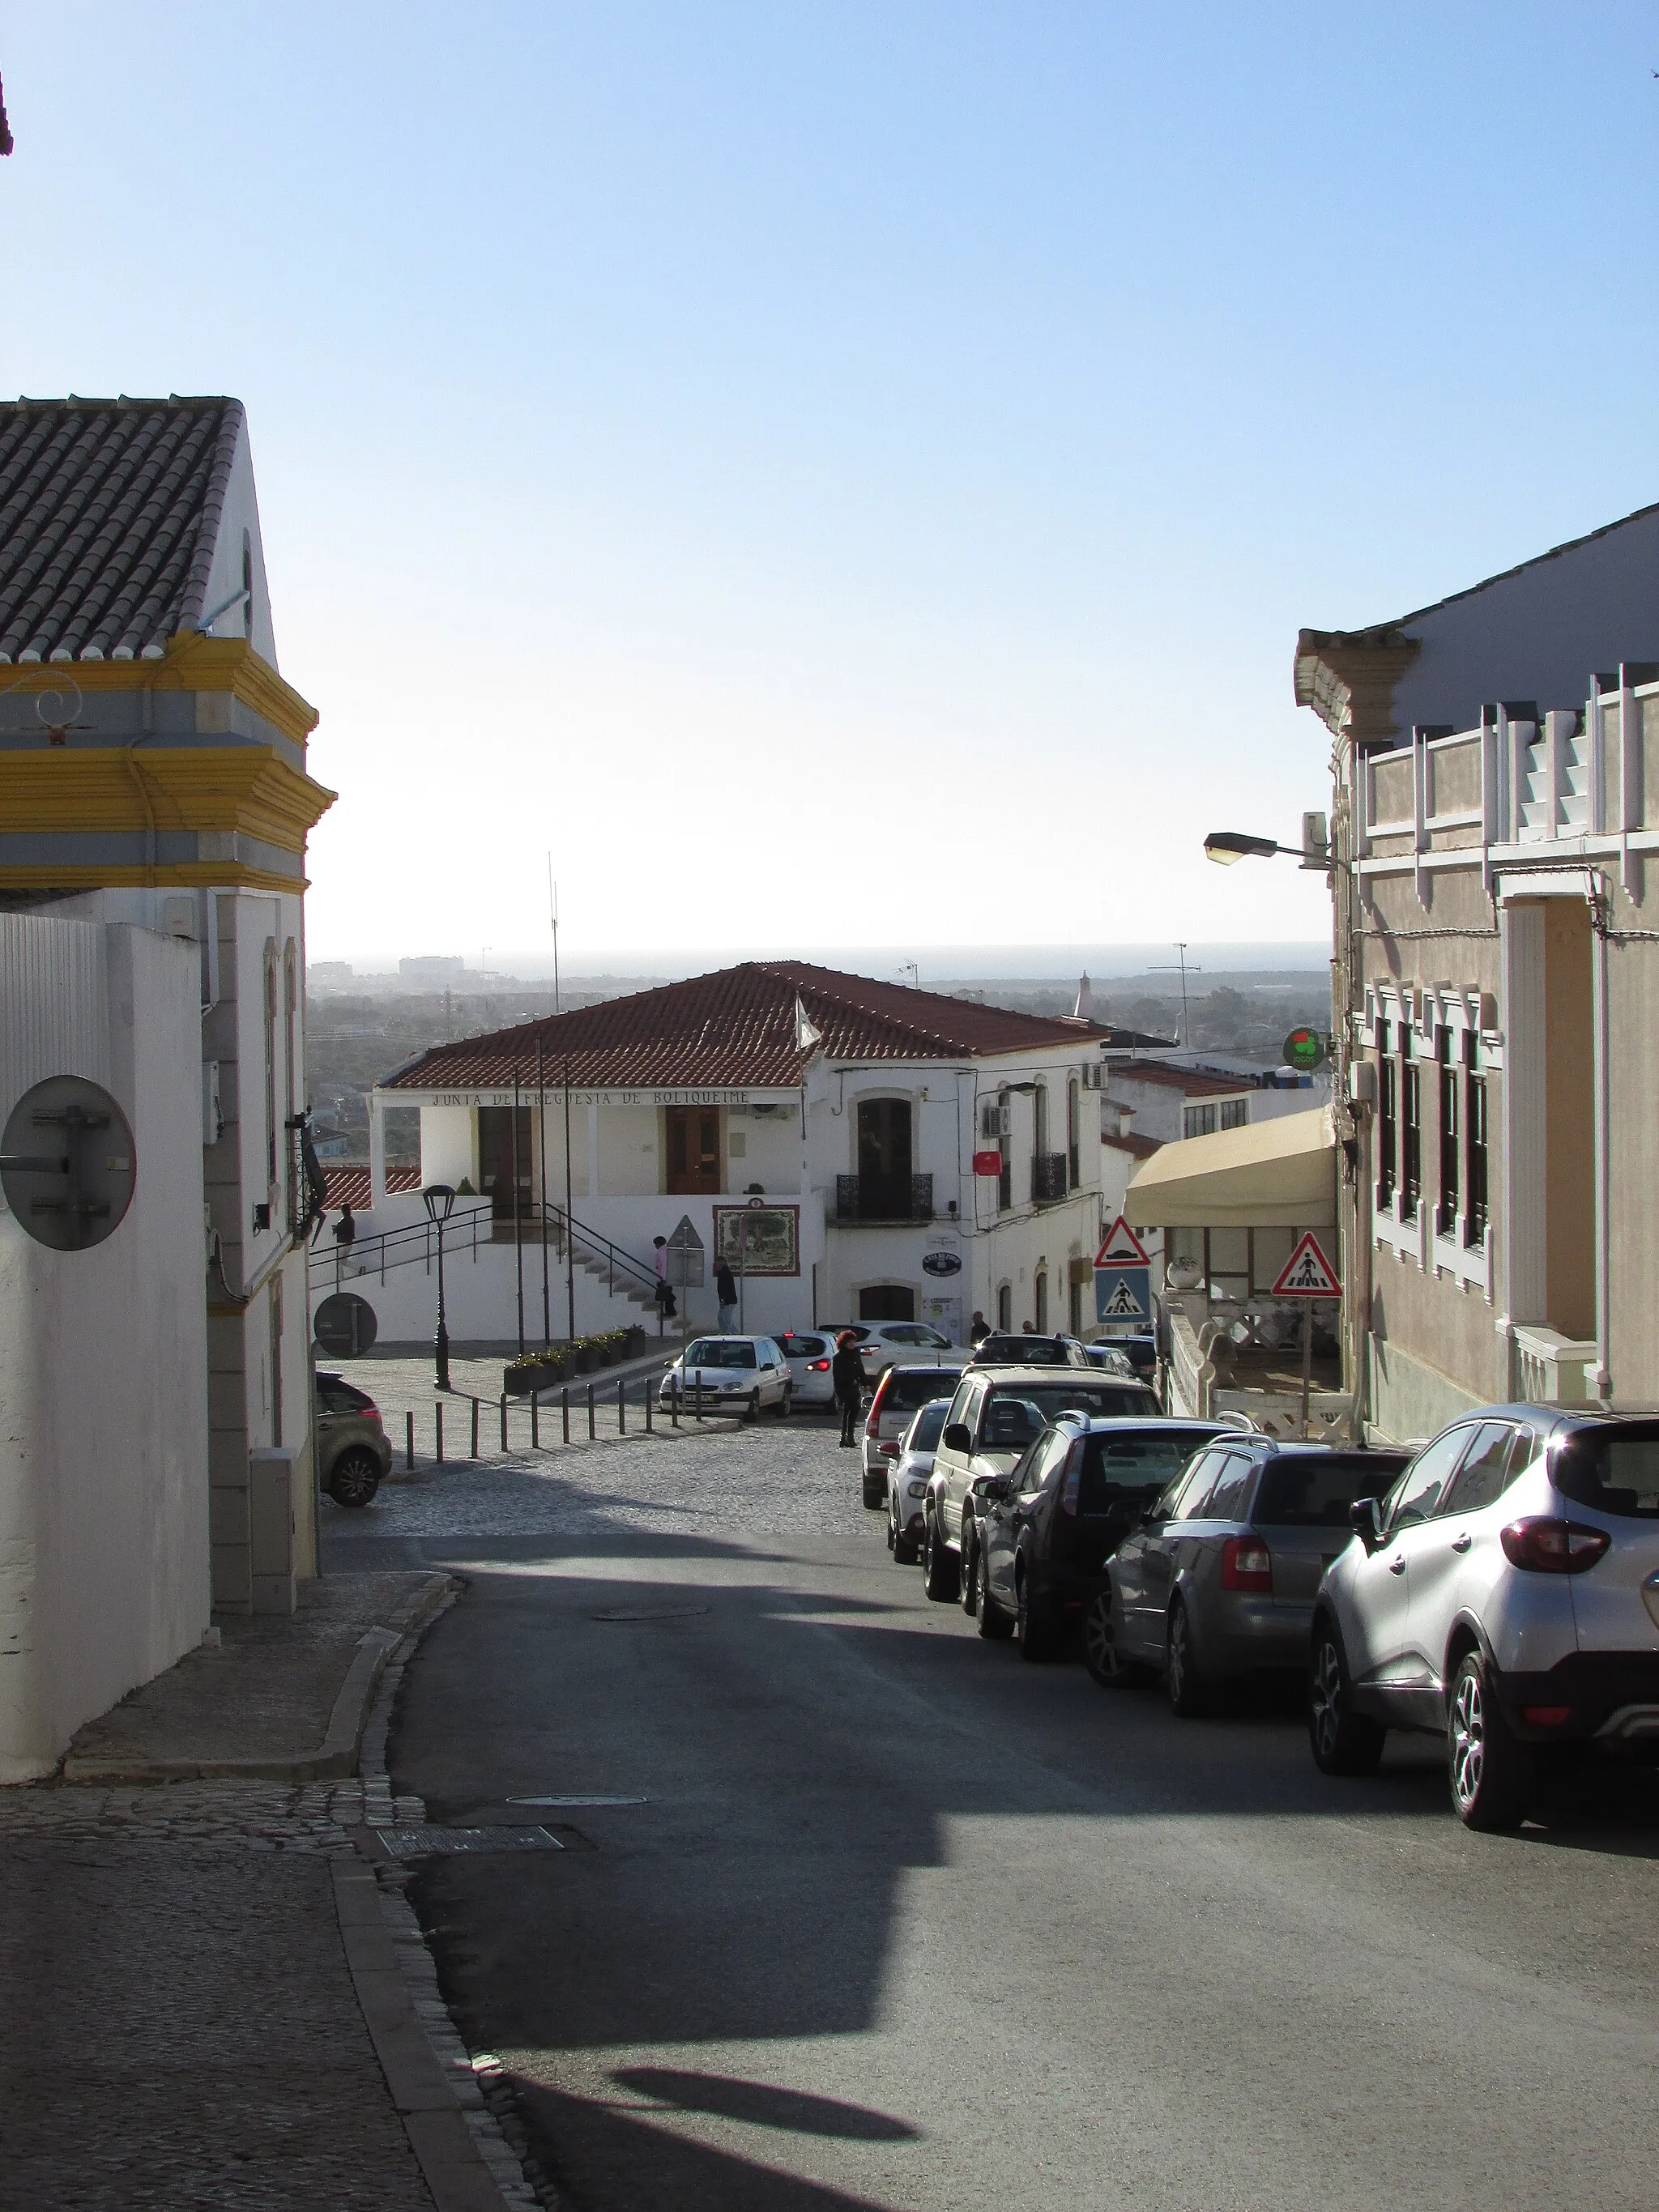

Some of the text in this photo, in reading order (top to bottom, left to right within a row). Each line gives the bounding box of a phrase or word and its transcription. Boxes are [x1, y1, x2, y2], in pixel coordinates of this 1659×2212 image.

[433, 1094, 482, 1106] JUNTA
[493, 1094, 511, 1105] DE
[622, 1093, 641, 1104] DE
[654, 1092, 748, 1105] BOLIQUEIME
